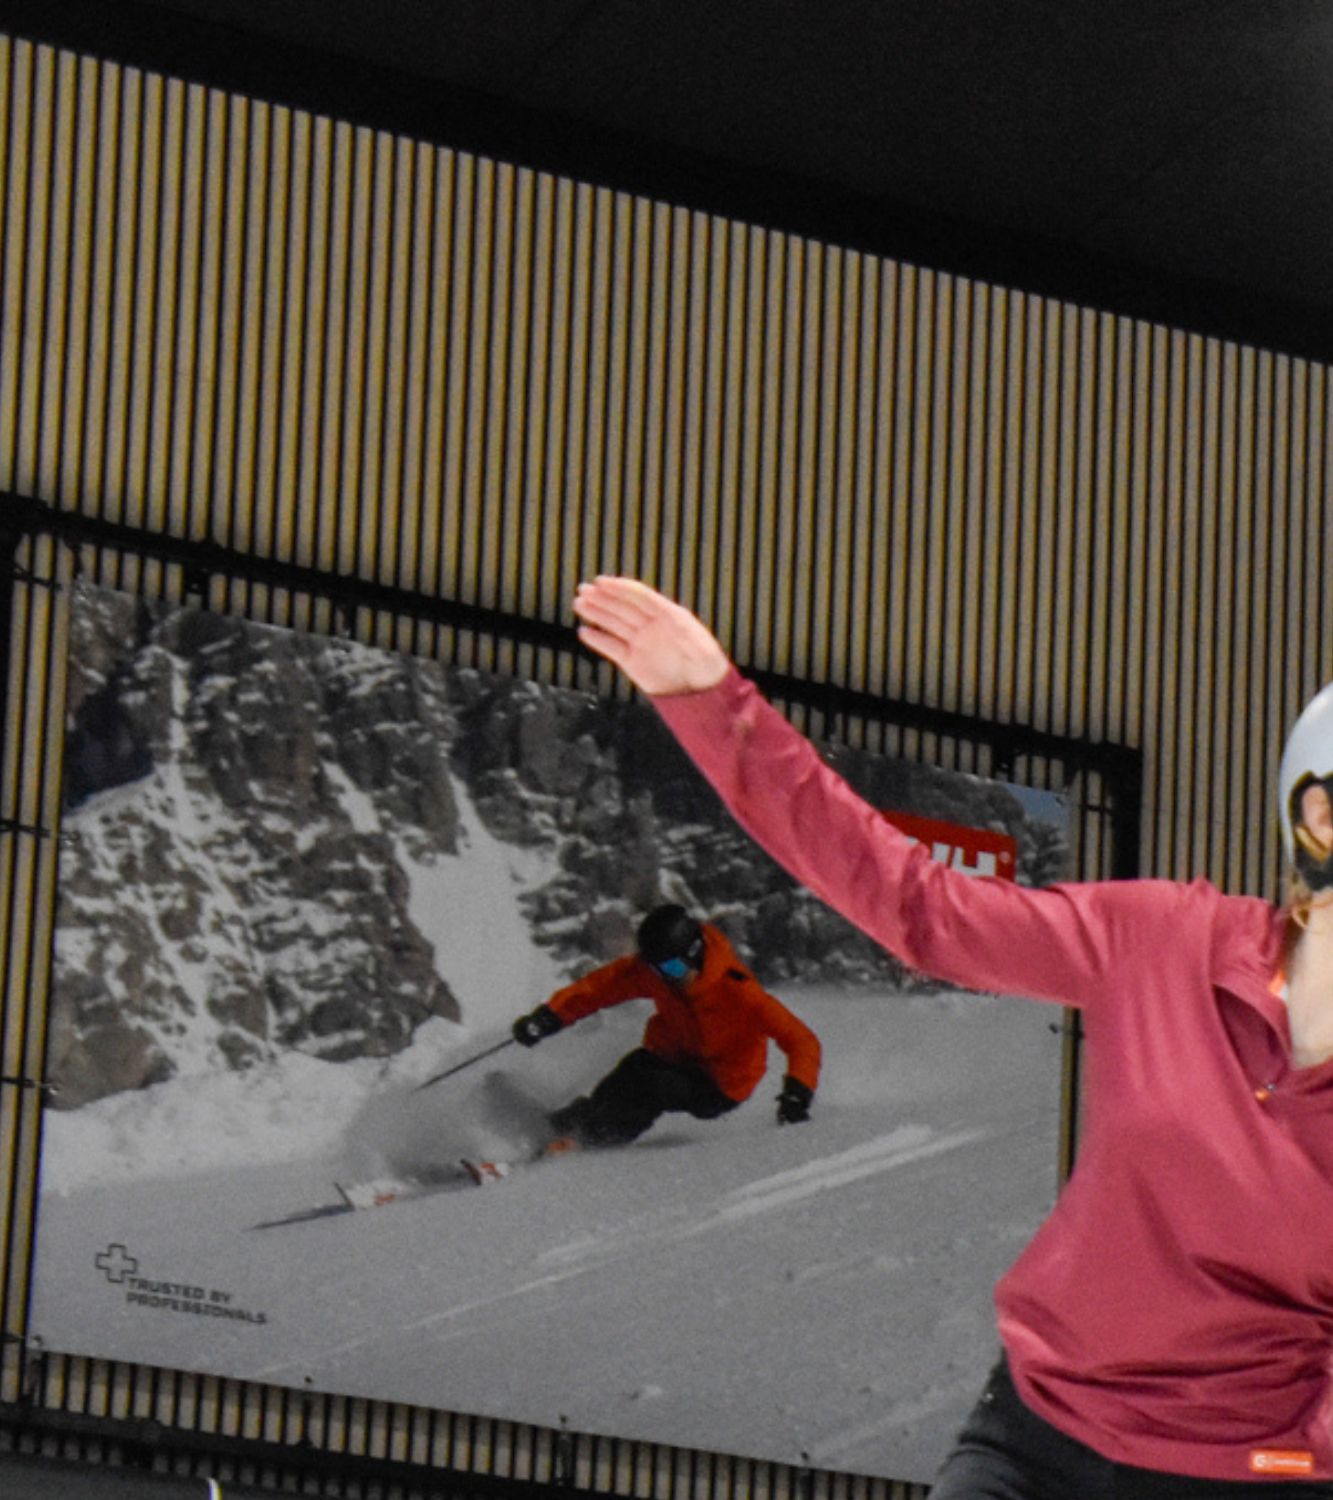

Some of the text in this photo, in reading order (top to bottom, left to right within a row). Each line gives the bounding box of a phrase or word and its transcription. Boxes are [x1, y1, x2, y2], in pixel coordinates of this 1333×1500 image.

[129, 1278, 232, 1304] TRUSTED BY
[127, 1291, 267, 1325] PROFESSIONALS
